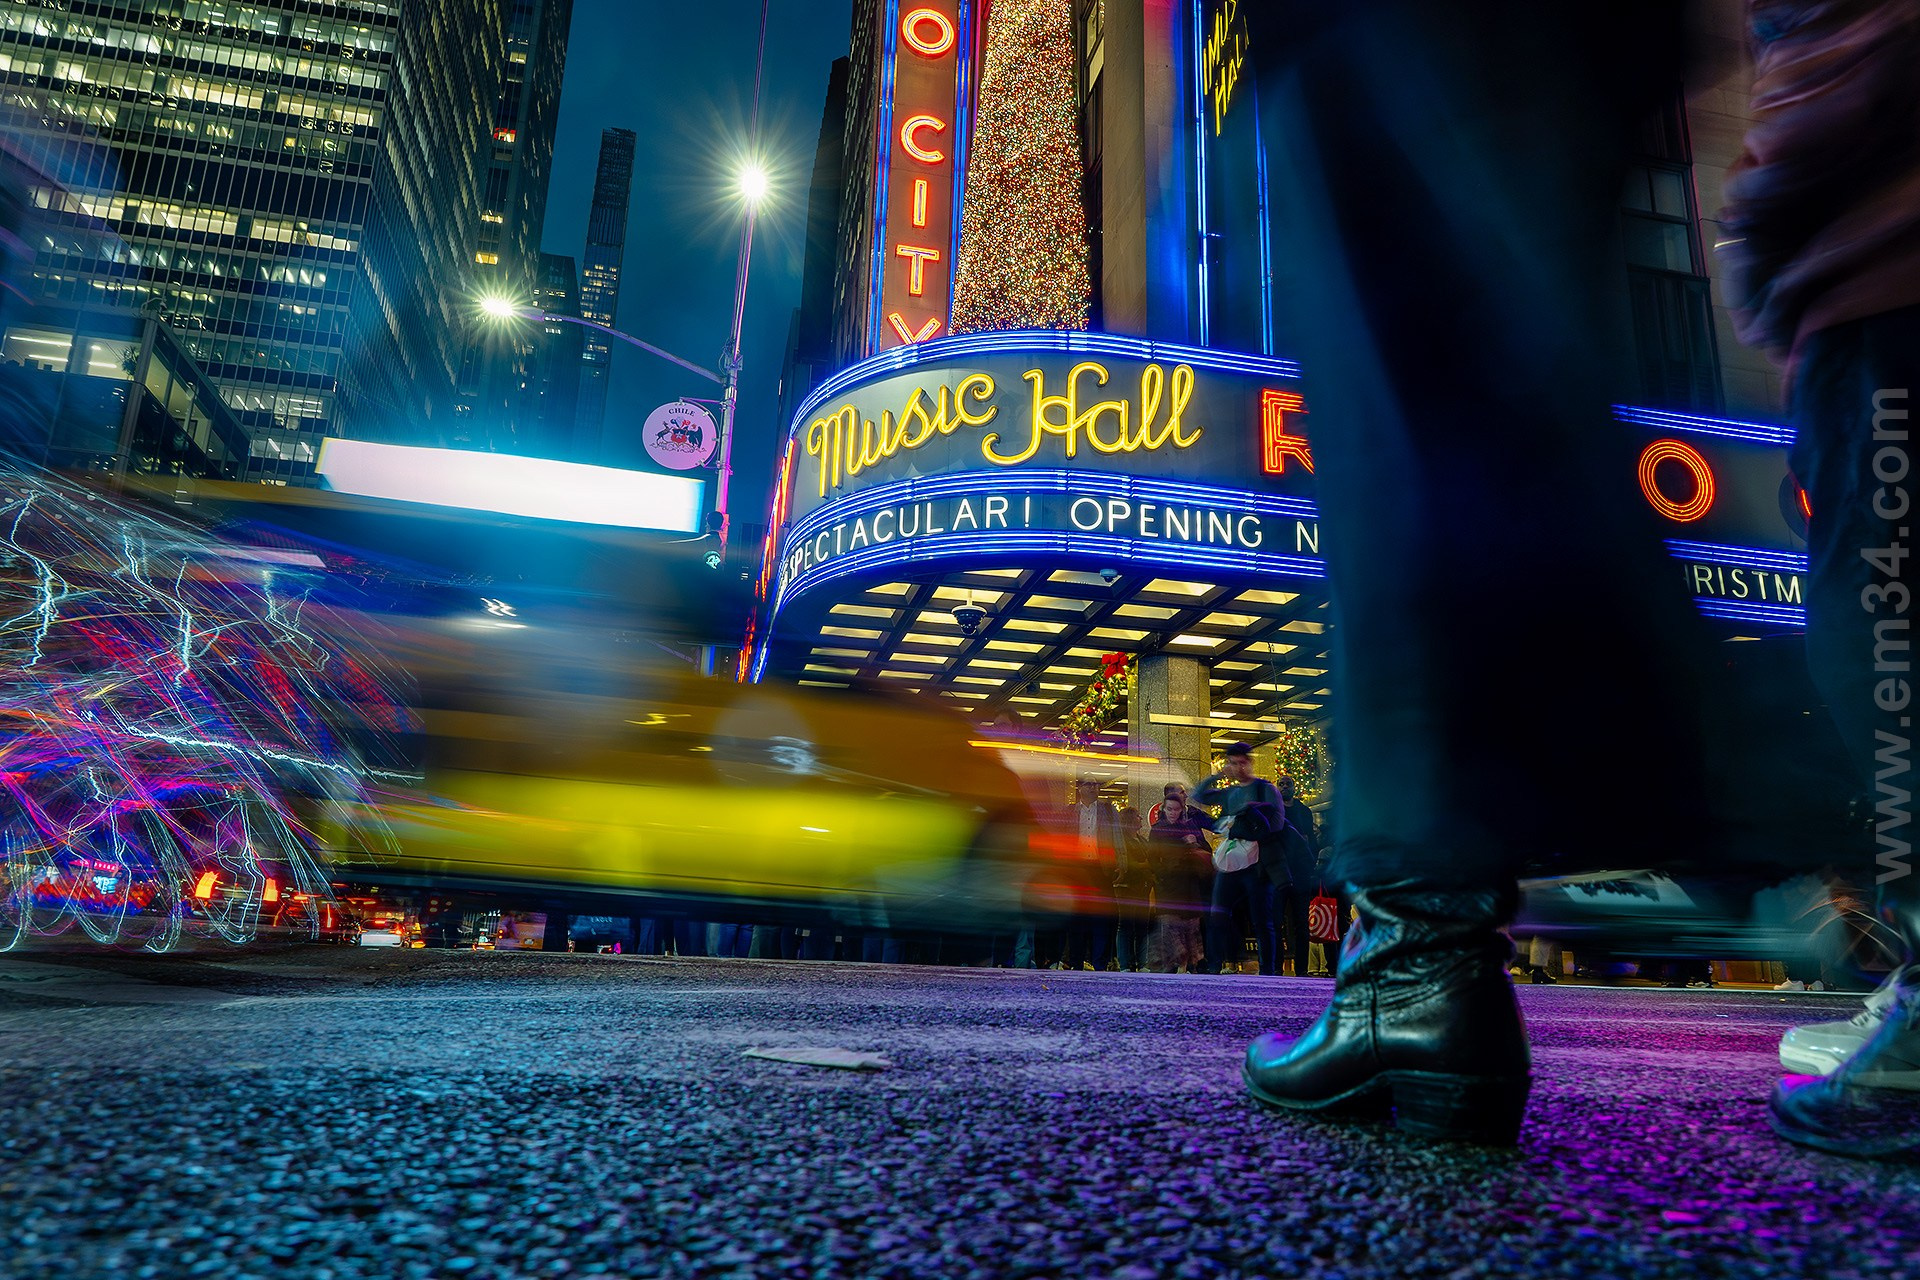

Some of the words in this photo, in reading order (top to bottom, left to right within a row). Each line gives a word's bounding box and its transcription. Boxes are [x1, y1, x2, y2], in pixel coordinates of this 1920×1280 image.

[887, 115, 946, 345] CITY
[668, 408, 696, 417] CHILE
[806, 373, 997, 498] Music
[981, 361, 1203, 465] Hall
[788, 496, 1031, 583] SPECTACULAR!
[1070, 497, 1263, 548] OPENING
[1683, 564, 1802, 604] RISTM
